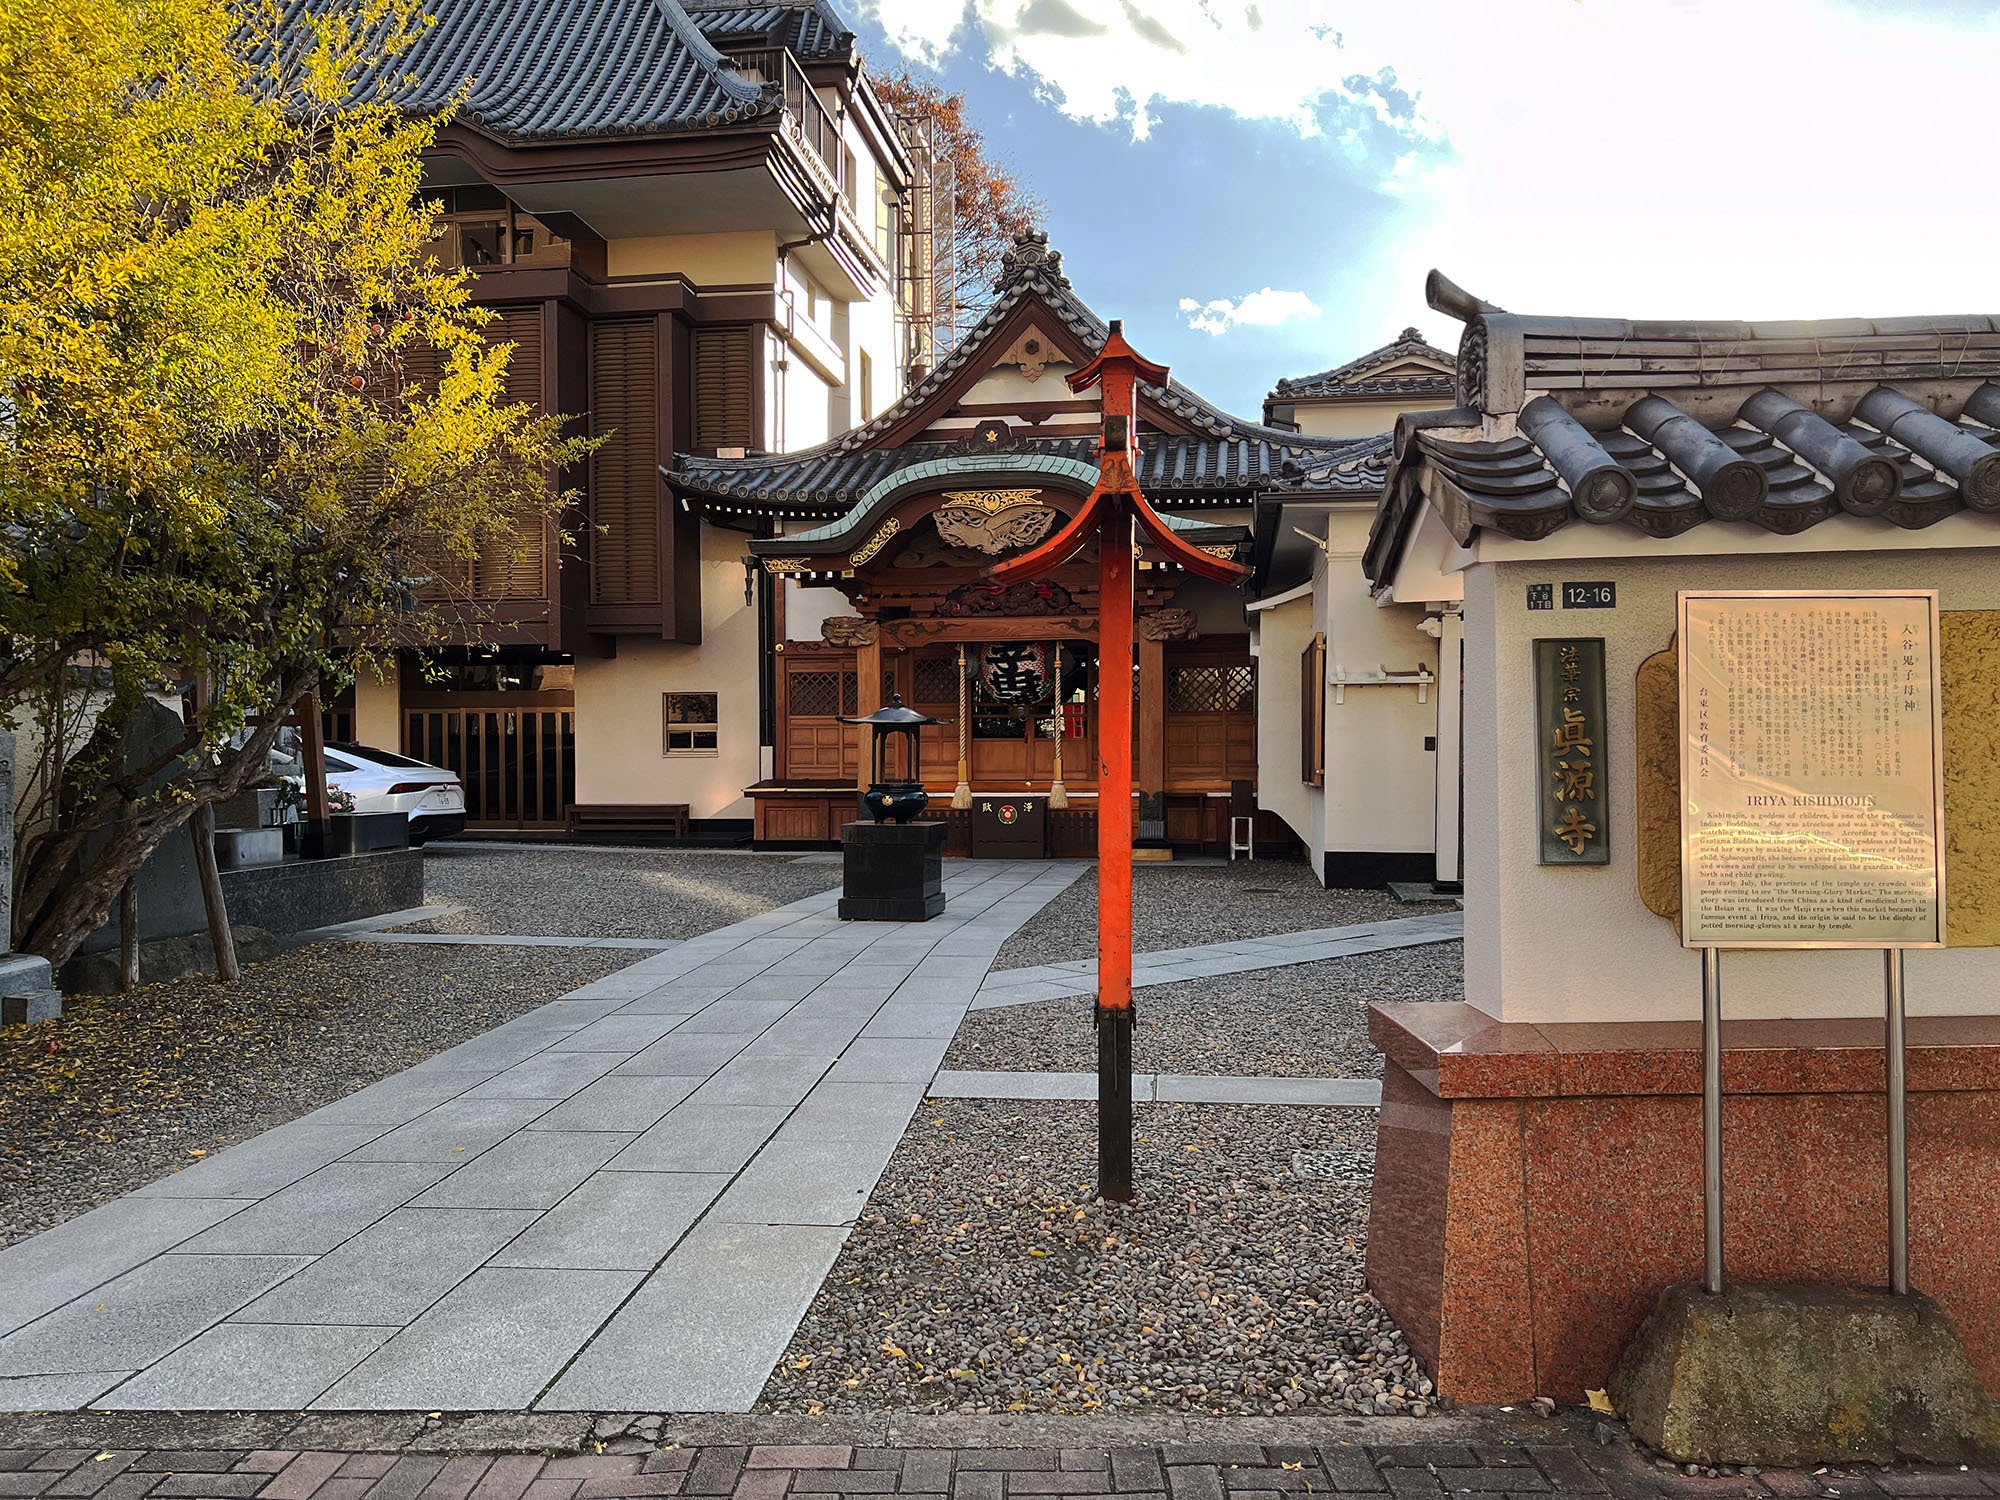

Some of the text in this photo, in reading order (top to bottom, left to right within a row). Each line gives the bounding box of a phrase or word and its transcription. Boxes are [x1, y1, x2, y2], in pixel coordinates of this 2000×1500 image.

[1568, 588, 1611, 602] 12-16
[1902, 623, 1915, 712] 入谷鬼子母神
[1699, 687, 1709, 777] 台東区教育委員会
[1554, 646, 1596, 856] 法華宗 眞源寺
[1747, 796, 1876, 806] IRIYA KISHIMOJIN
[1735, 870, 1786, 879] child-growing.
[1718, 879, 1736, 888] early
[1740, 879, 1756, 888] July,
[1776, 879, 1807, 888] precincts
[1837, 879, 1860, 888] temple
[1700, 888, 1722, 896] people
[1724, 888, 1749, 896] coming
[1791, 888, 1844, 896] Morning-Glory
[1701, 896, 1719, 905] glory
[1794, 905, 1811, 913] Meiji
[1760, 913, 1780, 922] Iriya,
[1810, 913, 1830, 922] origin
[1892, 913, 1917, 922] display
[1701, 922, 1723, 930] potted
[1725, 922, 1781, 930] morning-glories
[1829, 922, 1853, 930] temple.
